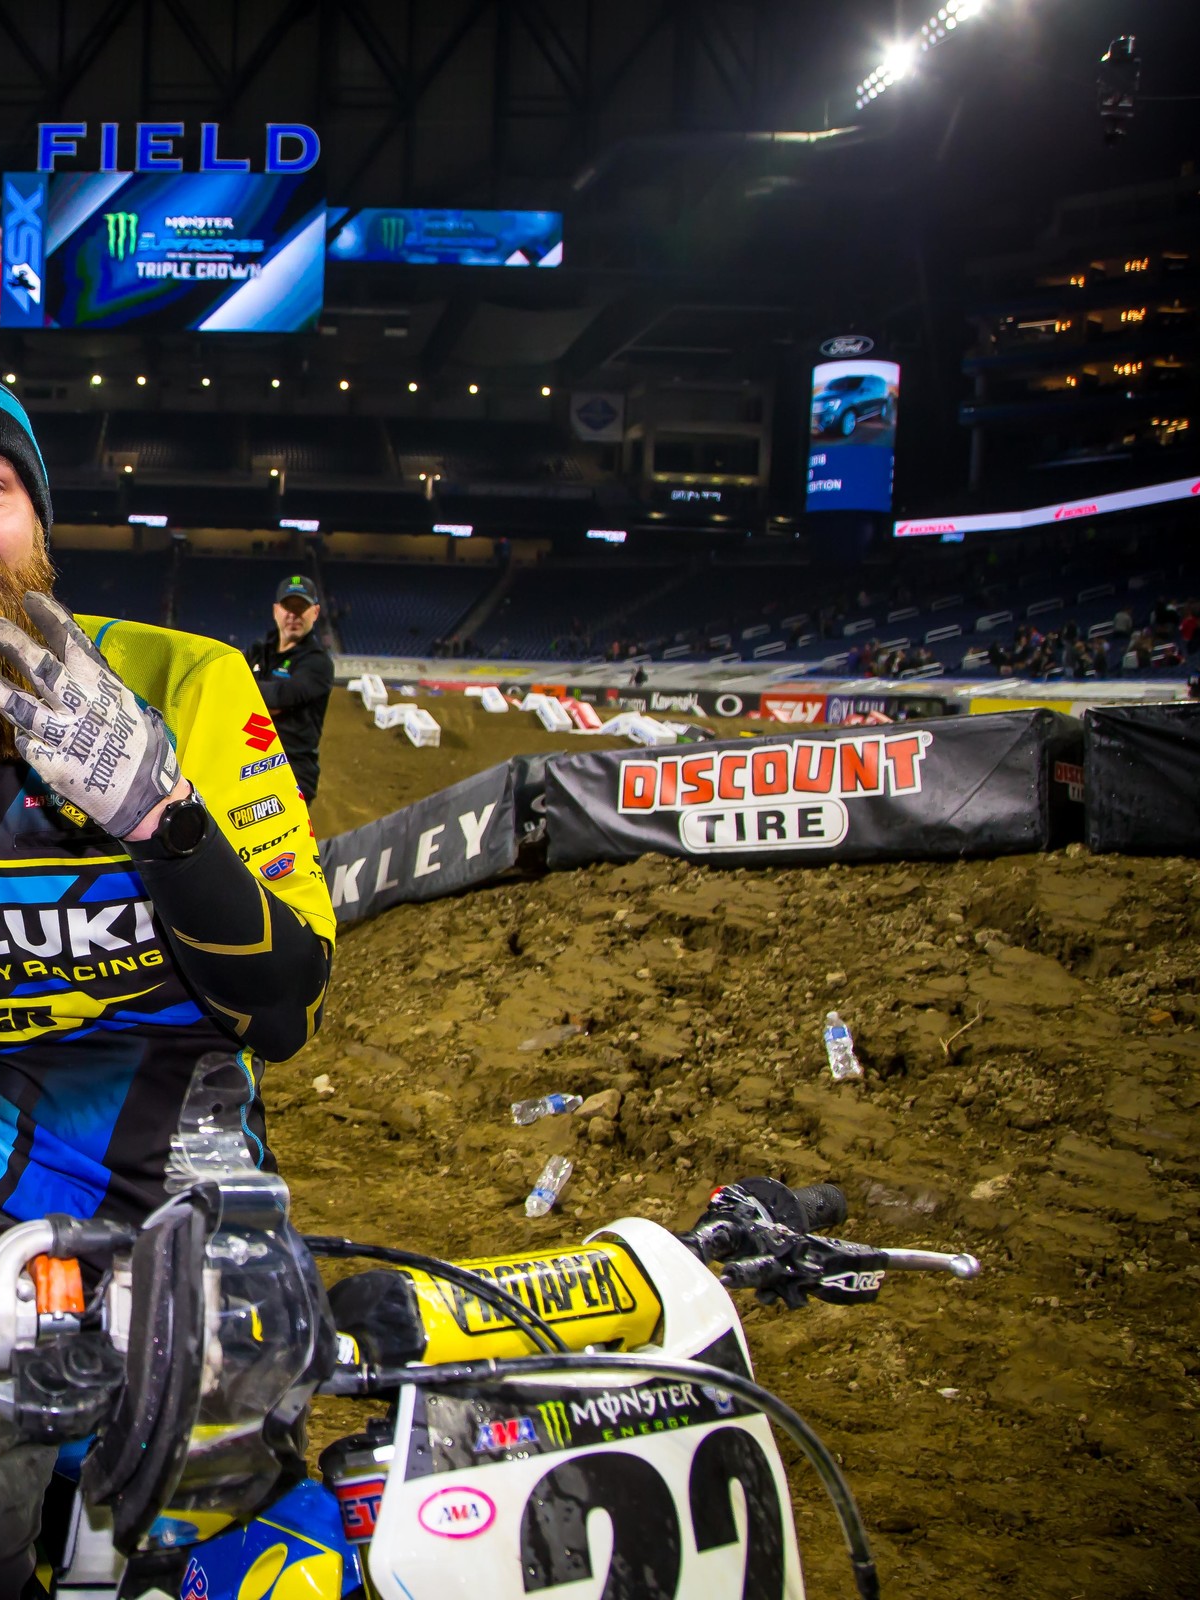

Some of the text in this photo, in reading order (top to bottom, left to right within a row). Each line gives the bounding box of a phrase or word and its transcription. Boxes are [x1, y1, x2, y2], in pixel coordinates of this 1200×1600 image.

[36, 121, 321, 173] FIELD
[164, 214, 235, 230] MONSTER
[136, 261, 262, 279] TRIPLE CROWN
[65, 669, 124, 766] Mechanix
[85, 701, 138, 795] Mechanix
[239, 752, 290, 781] ECSTA
[620, 732, 926, 813] DISCOUNT
[233, 796, 282, 827] PROTAPER
[696, 806, 827, 846] TIRE
[251, 824, 301, 856] SCOTT
[331, 799, 499, 909] KLEY
[26, 948, 165, 984] RACING
[569, 1383, 700, 1427] MONSTER
[474, 1416, 539, 1452] AMA
[601, 1414, 691, 1442] ENERGY
[436, 1502, 482, 1526] AMA
